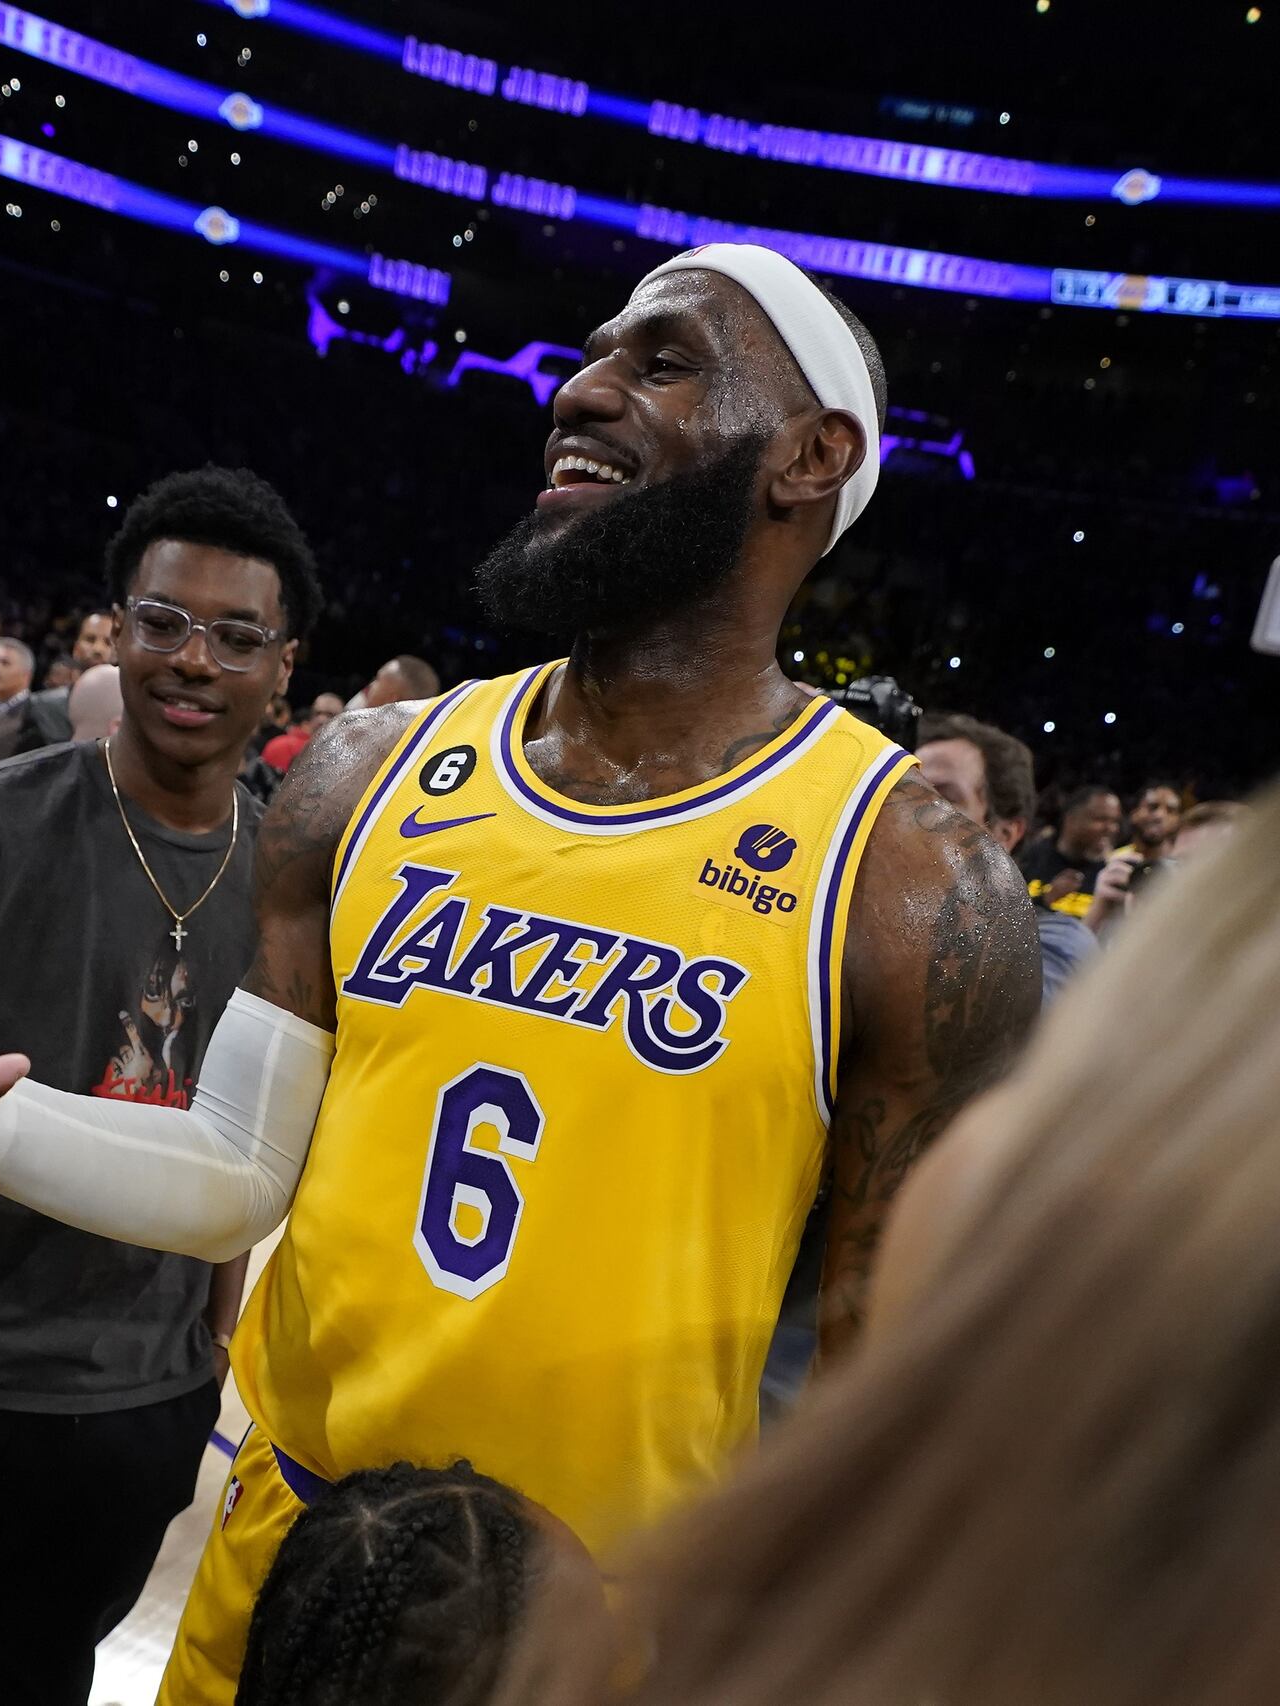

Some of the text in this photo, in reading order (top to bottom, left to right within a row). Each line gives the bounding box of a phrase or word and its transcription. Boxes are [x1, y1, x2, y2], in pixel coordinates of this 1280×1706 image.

[429, 753, 468, 790] 6
[698, 858, 798, 915] bibigo
[341, 861, 751, 1076] LAKERS
[412, 1060, 548, 1303] 6
